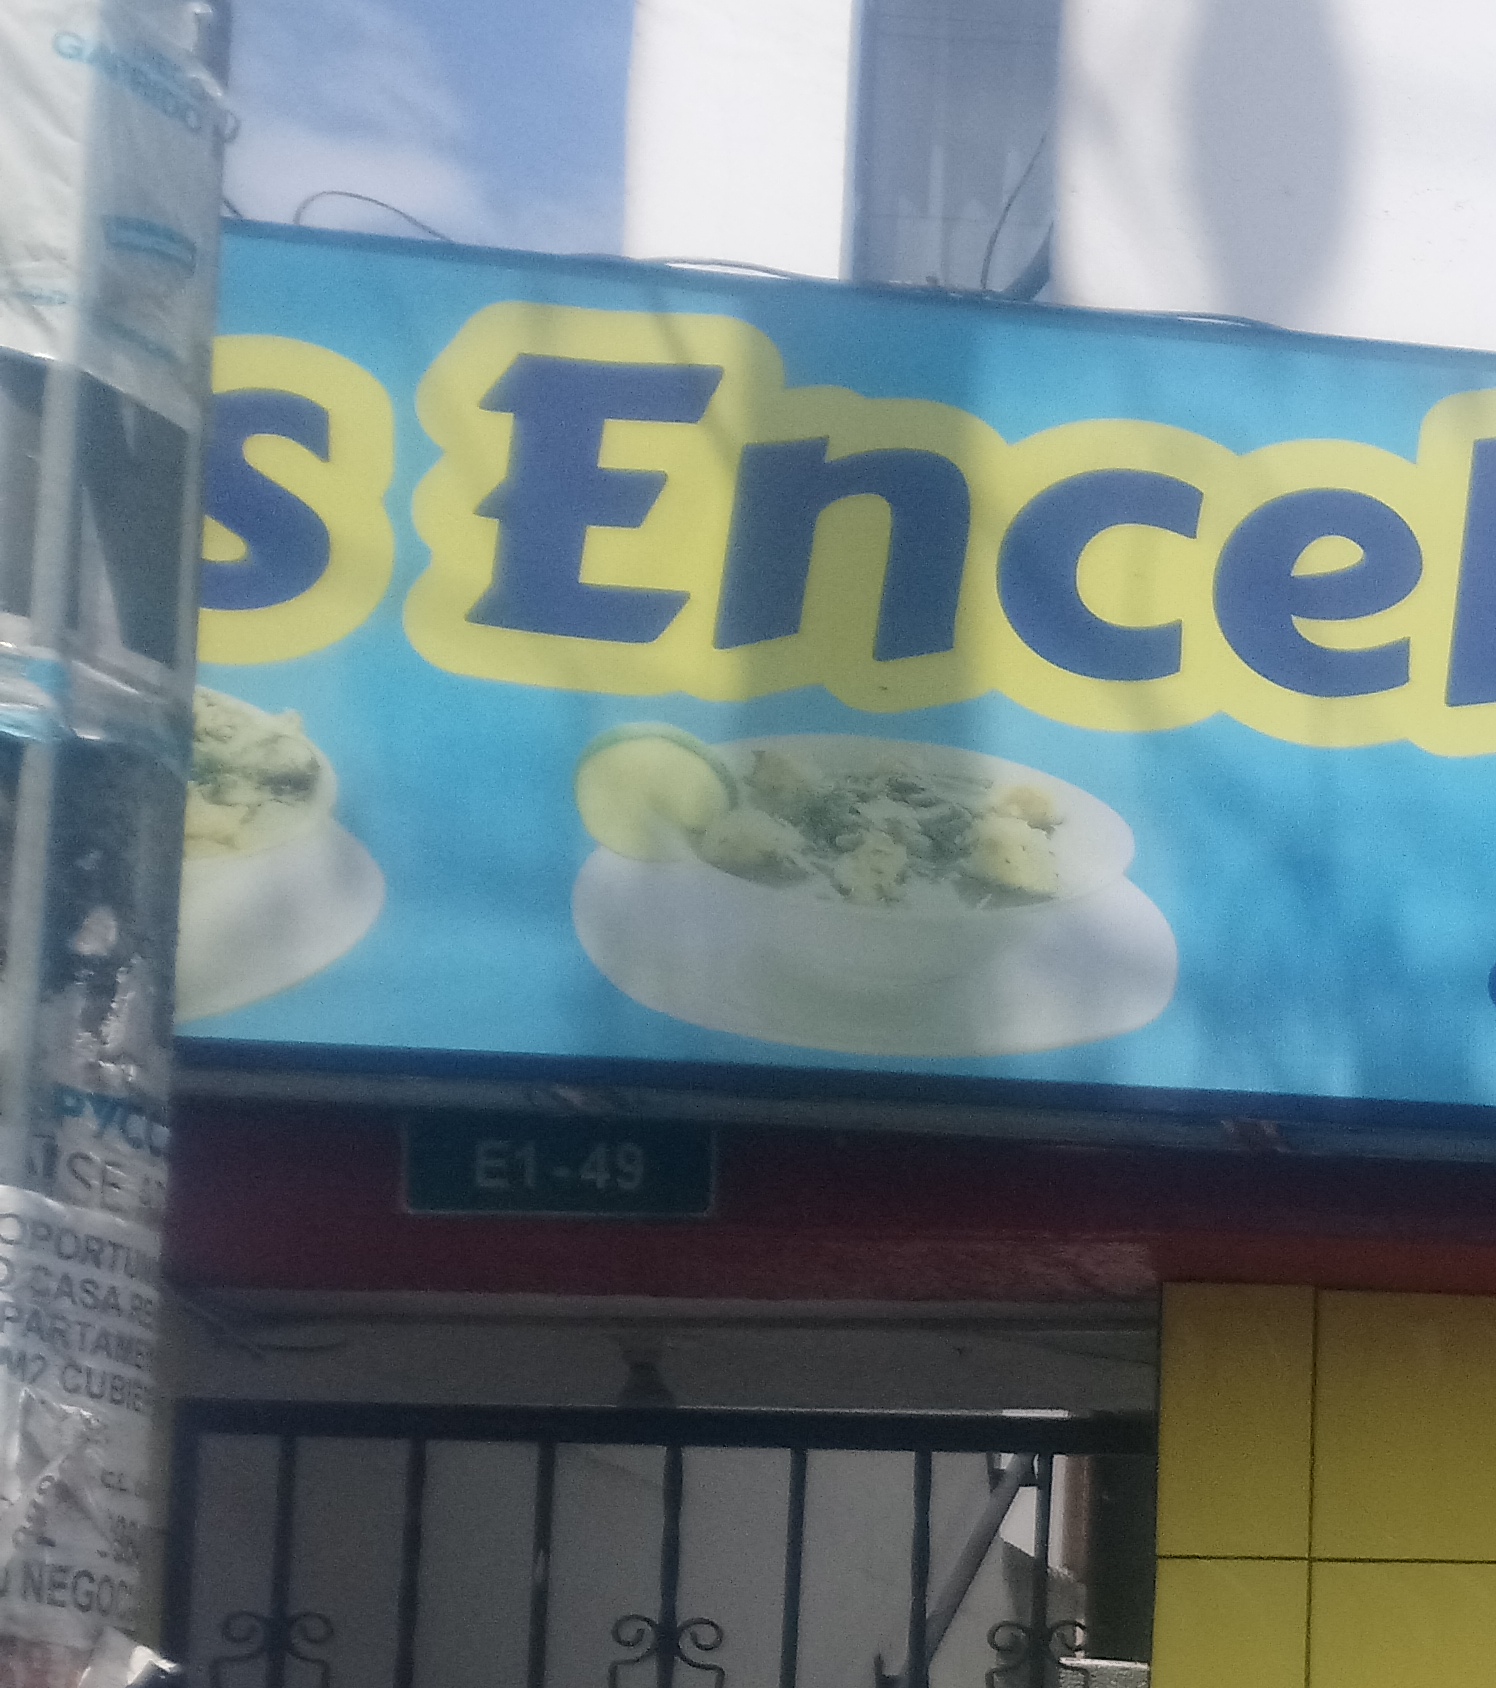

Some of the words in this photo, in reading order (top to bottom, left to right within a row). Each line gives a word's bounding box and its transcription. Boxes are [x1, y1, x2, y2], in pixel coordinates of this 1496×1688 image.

[198, 386, 333, 613] s
[474, 1139, 645, 1191] E1-49
[0, 1213, 150, 1280] OPORTU
